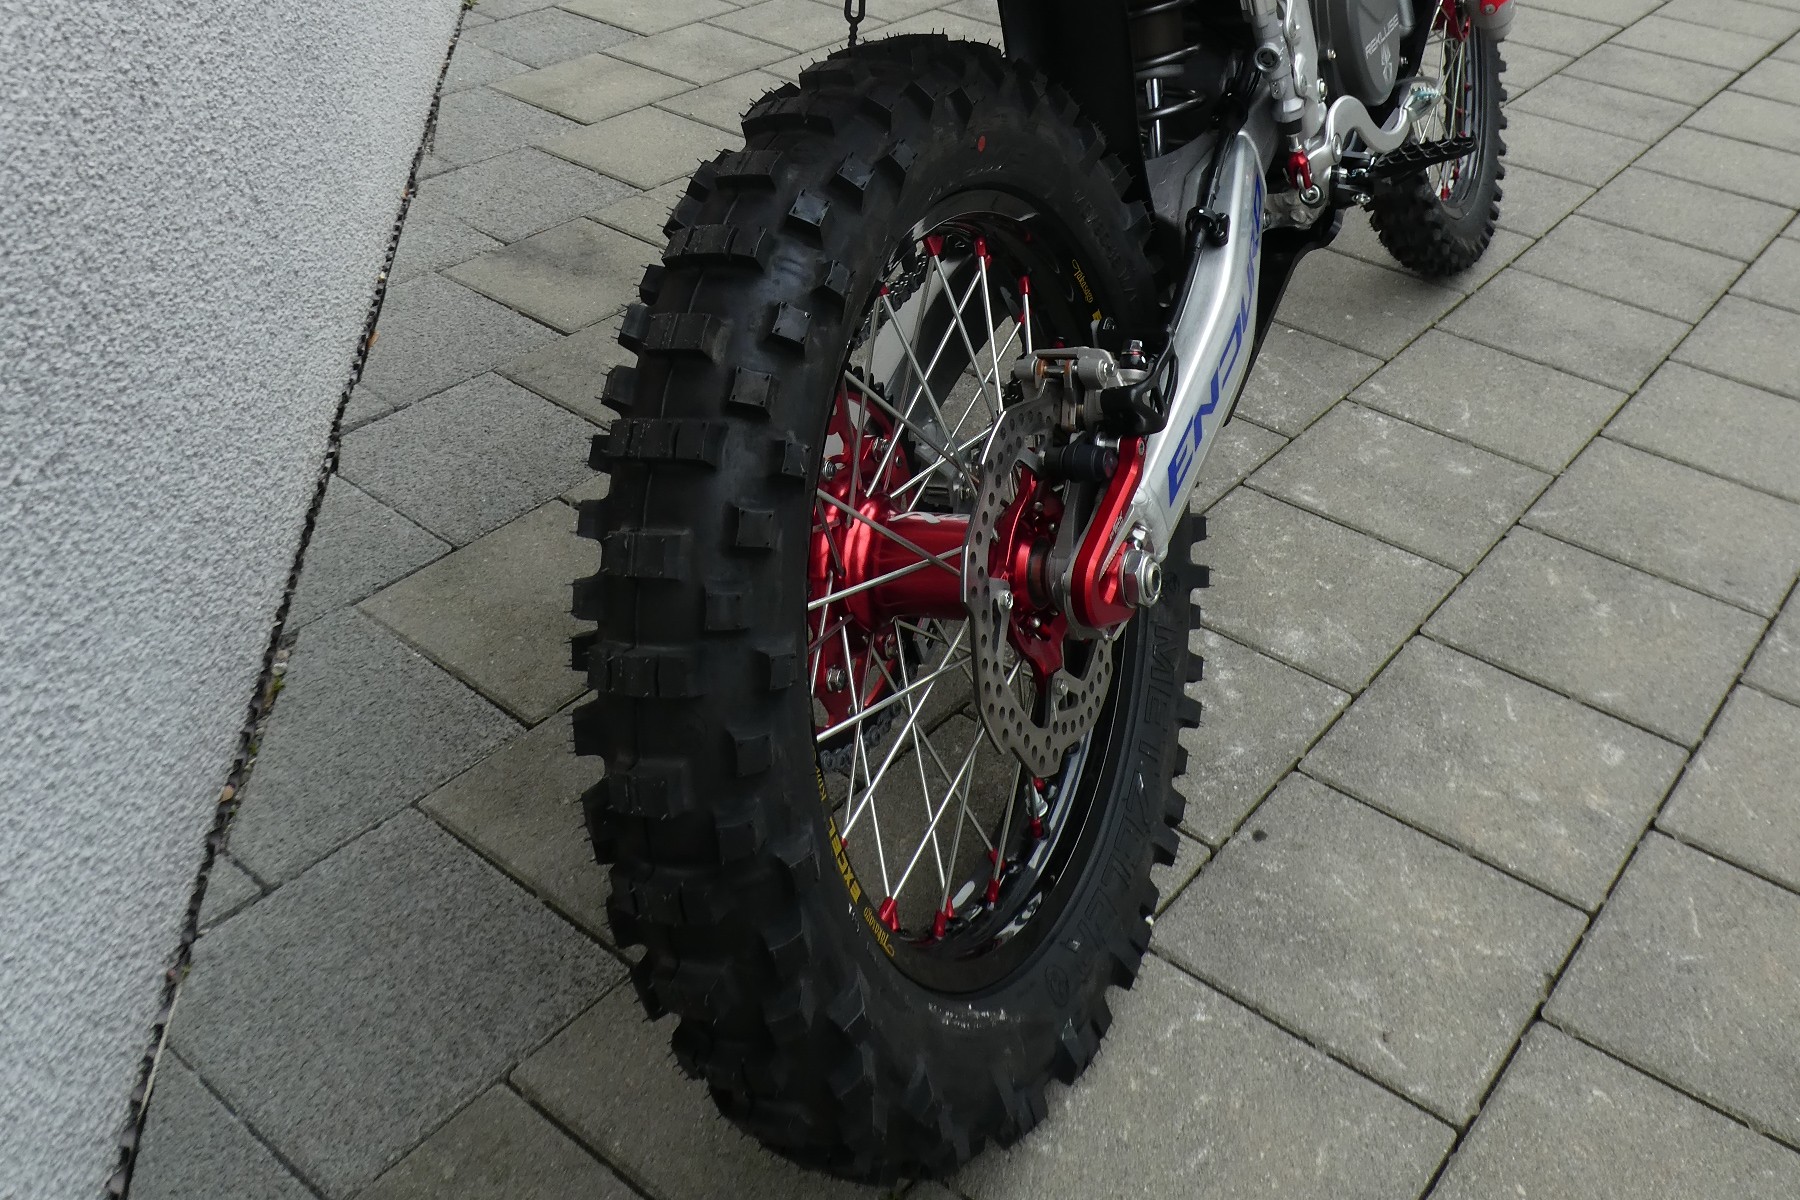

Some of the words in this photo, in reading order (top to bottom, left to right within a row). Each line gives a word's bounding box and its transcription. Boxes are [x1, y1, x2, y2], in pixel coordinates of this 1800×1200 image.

[1364, 13, 1400, 59] REKLUSE
[1072, 258, 1094, 304] Takasago
[1168, 173, 1264, 508] ENDURO
[828, 816, 862, 905] EXCEL
